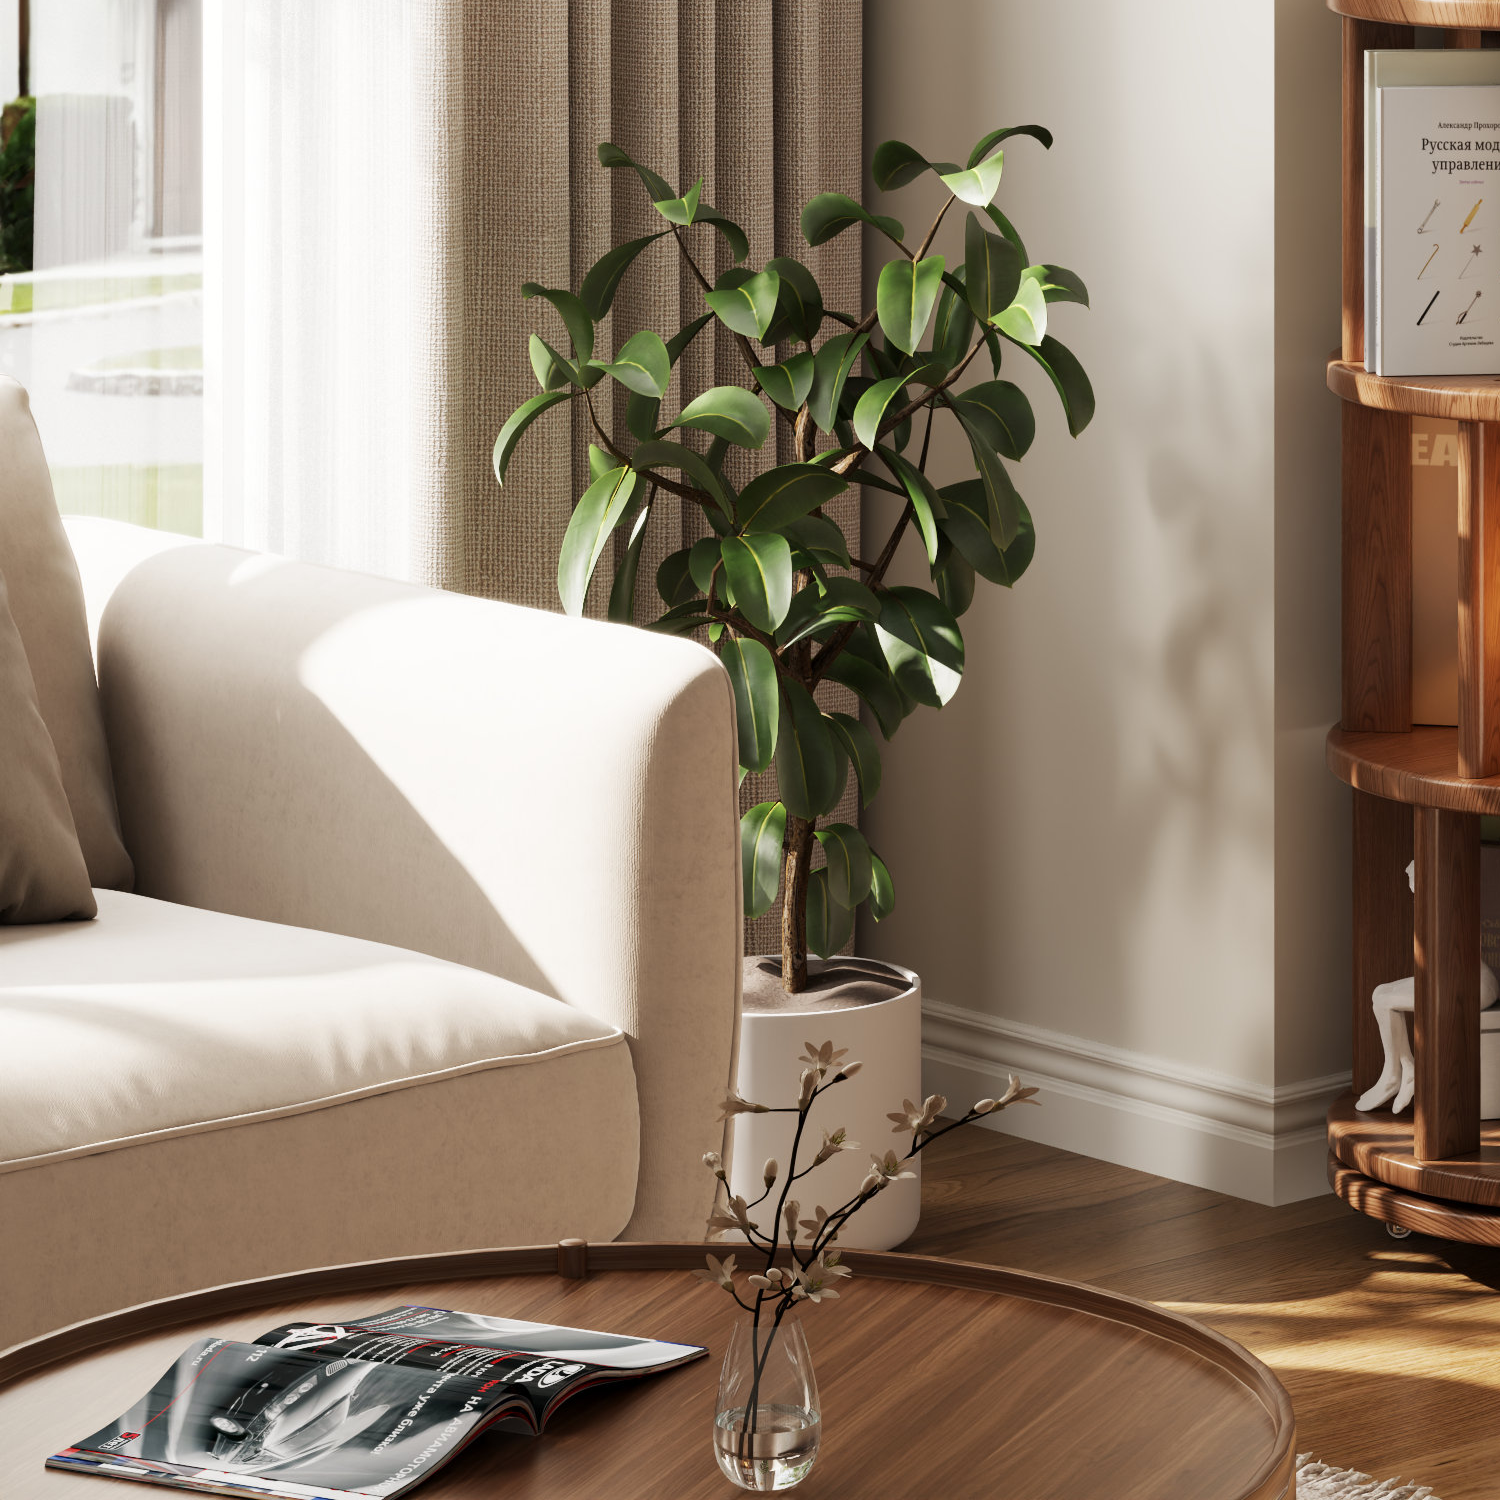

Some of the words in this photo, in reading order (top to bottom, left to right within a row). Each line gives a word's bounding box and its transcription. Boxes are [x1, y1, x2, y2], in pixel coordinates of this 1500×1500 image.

[1438, 122, 1473, 130] Александр
[1421, 138, 1472, 155] Русская
[514, 1360, 565, 1383] LADA
[407, 1394, 430, 1417] уже
[459, 1395, 482, 1412] НА
